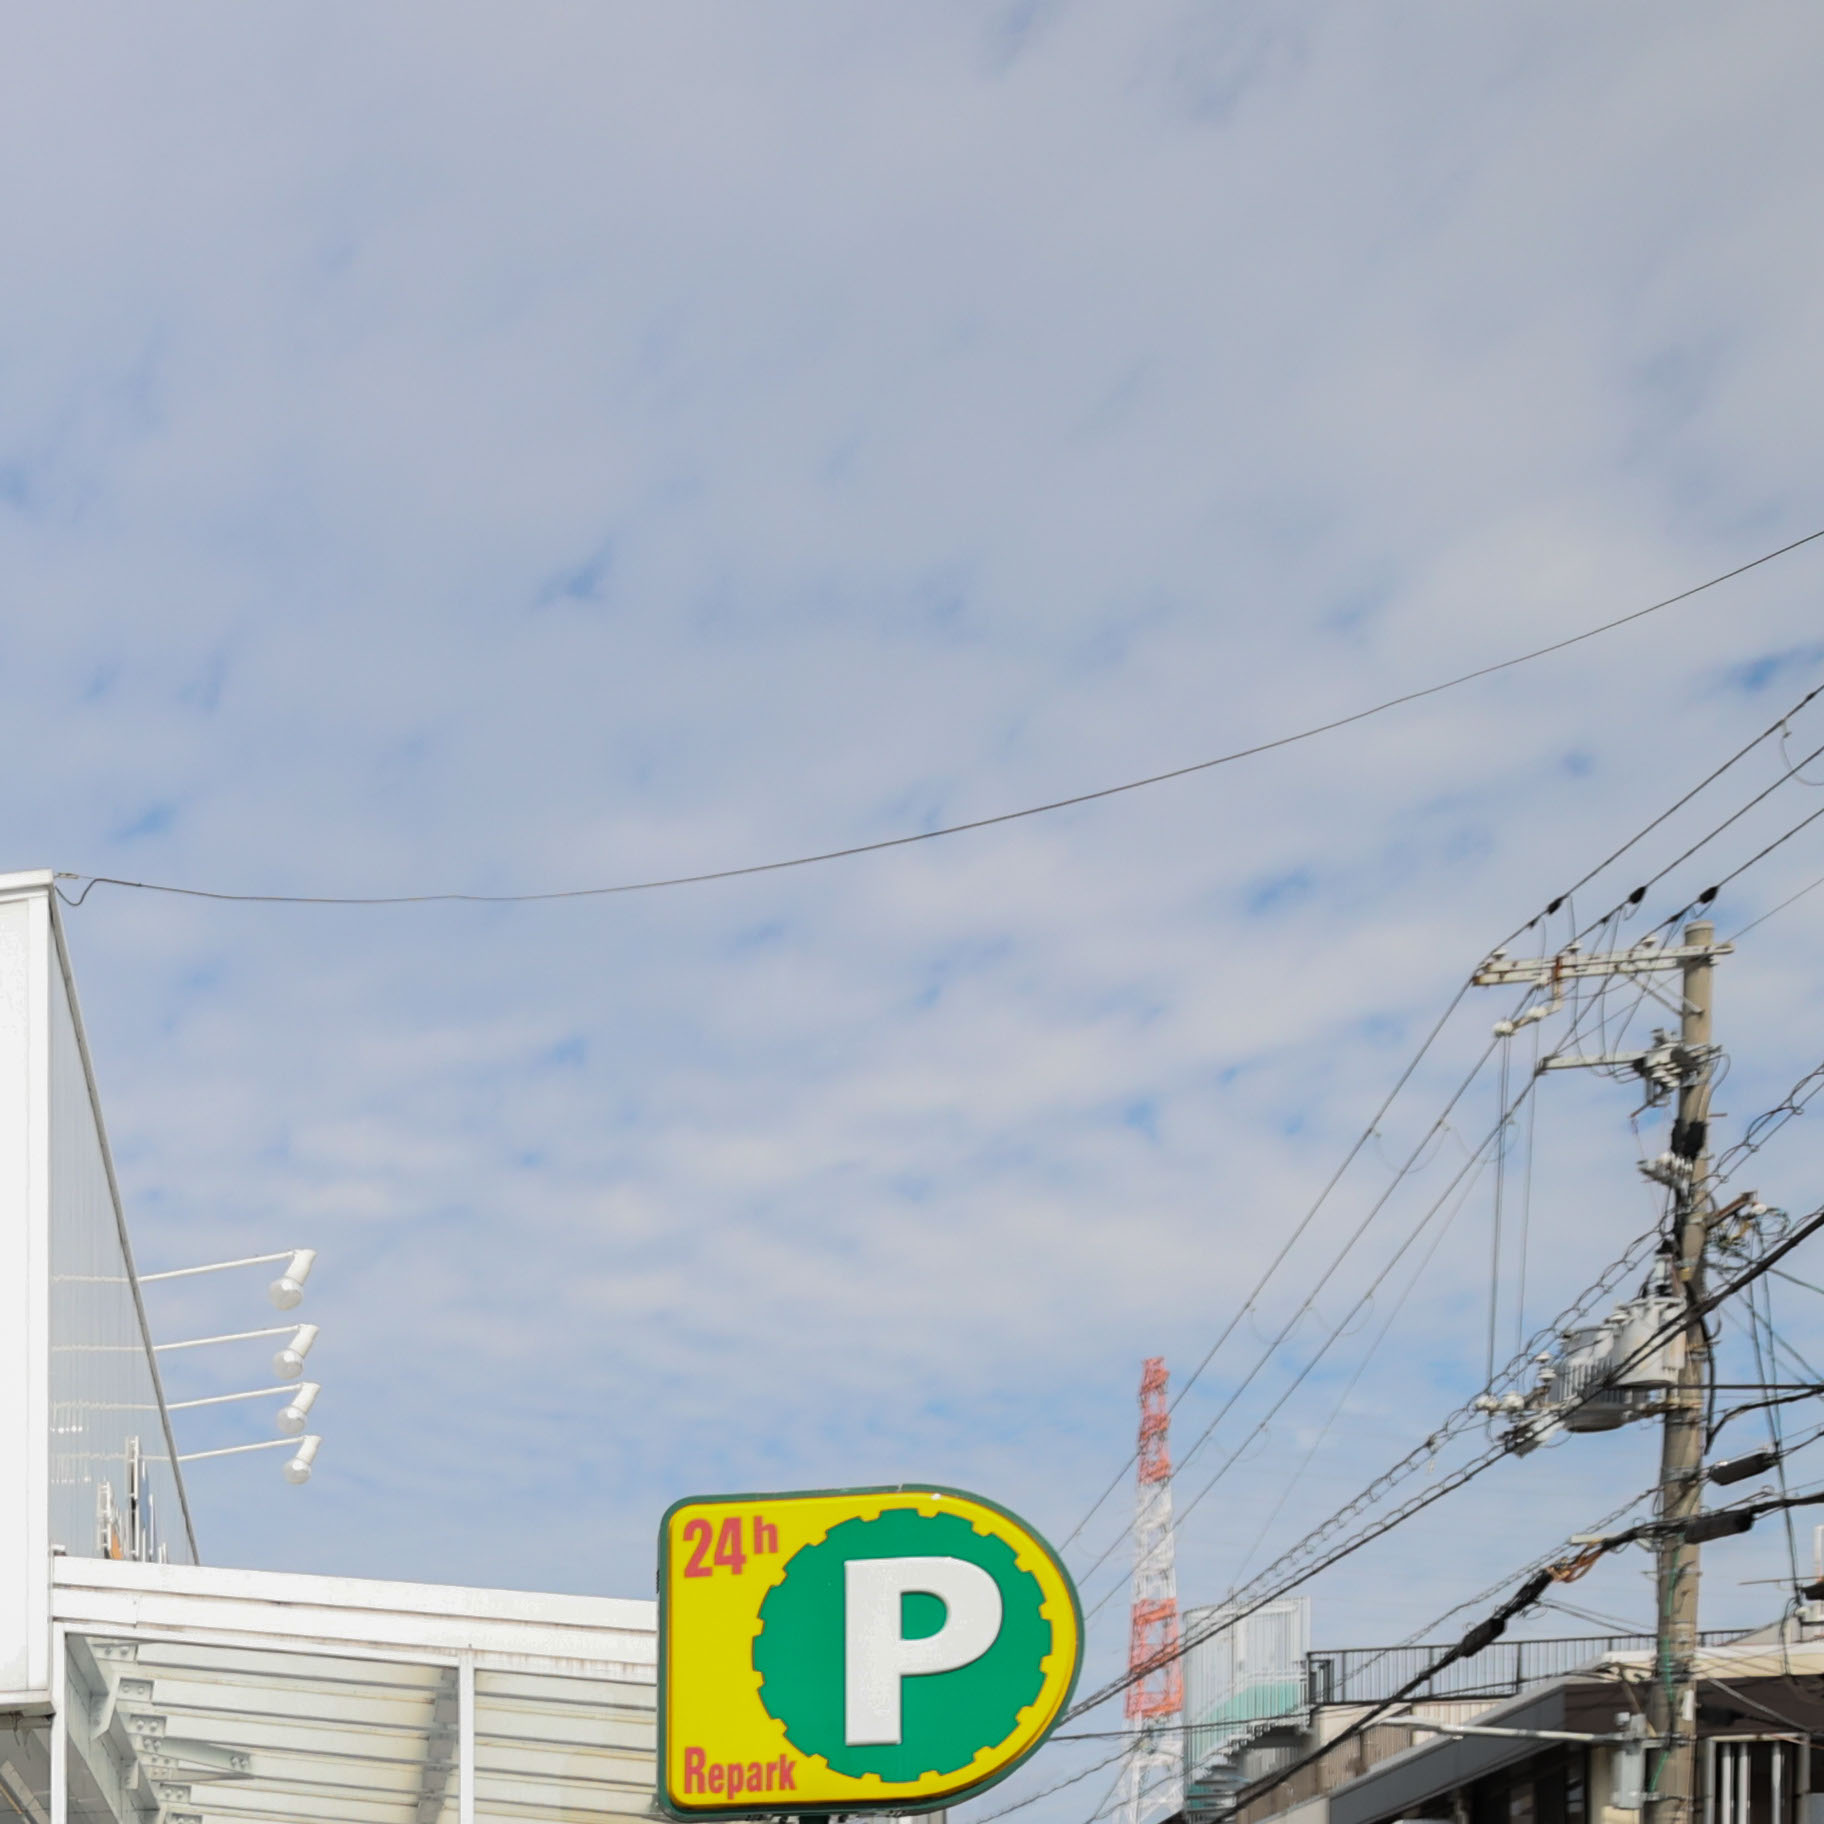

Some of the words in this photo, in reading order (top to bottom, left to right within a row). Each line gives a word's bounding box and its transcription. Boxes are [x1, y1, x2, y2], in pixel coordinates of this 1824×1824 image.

[683, 1515, 779, 1579] 24h
[843, 1555, 1004, 1746] P
[683, 1746, 798, 1799] Repark
